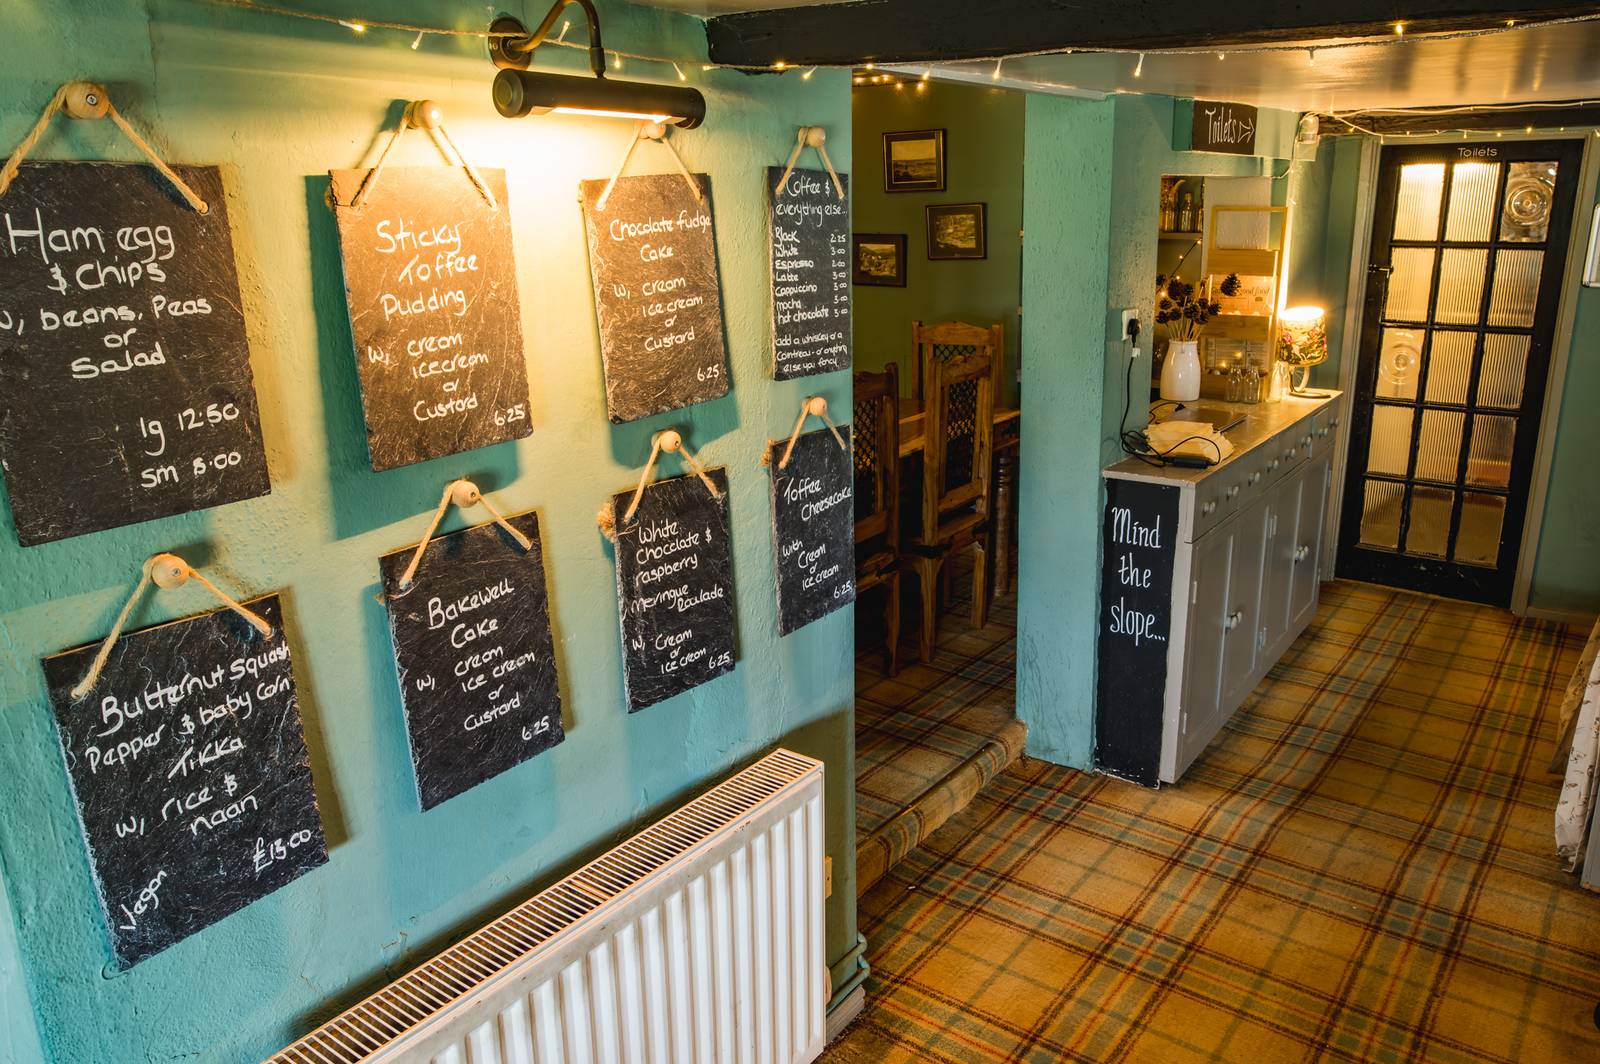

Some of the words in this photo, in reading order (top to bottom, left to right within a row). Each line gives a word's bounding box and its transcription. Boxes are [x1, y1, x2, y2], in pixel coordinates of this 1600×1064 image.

[1205, 107, 1236, 144] Toilets
[1458, 148, 1497, 157] Toilets
[787, 172, 820, 196] Coffee
[610, 217, 673, 241] Chocolate
[677, 210, 711, 233] fudge
[776, 202, 822, 227] everything
[5, 208, 105, 264] Ham
[118, 226, 175, 260] egg
[375, 220, 461, 253] Sticky
[775, 227, 800, 247] Black
[640, 245, 673, 262] Cake
[776, 244, 798, 257] White
[76, 256, 166, 290] Chips
[399, 254, 478, 285] Toffee
[776, 260, 814, 272] Espresso
[776, 272, 798, 281] Latte
[776, 282, 817, 296] Cappuccino
[381, 288, 466, 320] Pudding
[667, 296, 703, 313] cream
[778, 311, 791, 324] hot
[794, 305, 829, 322] chocolate
[665, 316, 677, 327] or
[104, 329, 136, 349] or
[408, 333, 463, 356] cream
[645, 327, 695, 351] Custard
[776, 334, 791, 345] add
[697, 364, 719, 381] 6.25
[784, 363, 801, 372] else
[803, 363, 815, 371] you
[819, 358, 837, 366] fancy
[443, 380, 458, 392] or
[414, 393, 478, 421] Custard
[494, 404, 525, 426] 6.25
[784, 477, 822, 504] Toffee
[638, 519, 679, 545] White
[1112, 507, 1161, 548] Mind
[634, 553, 697, 587] raspberry
[810, 563, 818, 575] or
[815, 564, 839, 584] cream
[1118, 552, 1151, 588] the
[834, 582, 851, 598] 6.25
[428, 577, 514, 630] Bakewell
[452, 618, 499, 649] Cake
[492, 650, 535, 678] cream
[670, 646, 681, 659] or
[680, 647, 706, 667] cream
[709, 651, 730, 669] 6.25
[97, 667, 225, 737] Butternut
[488, 684, 504, 700] or
[199, 691, 253, 725] baby
[464, 692, 521, 731] Custard
[522, 716, 549, 741] 6.25
[169, 736, 246, 780] Tikka
[161, 787, 213, 820] rice
[190, 794, 258, 835] naan
